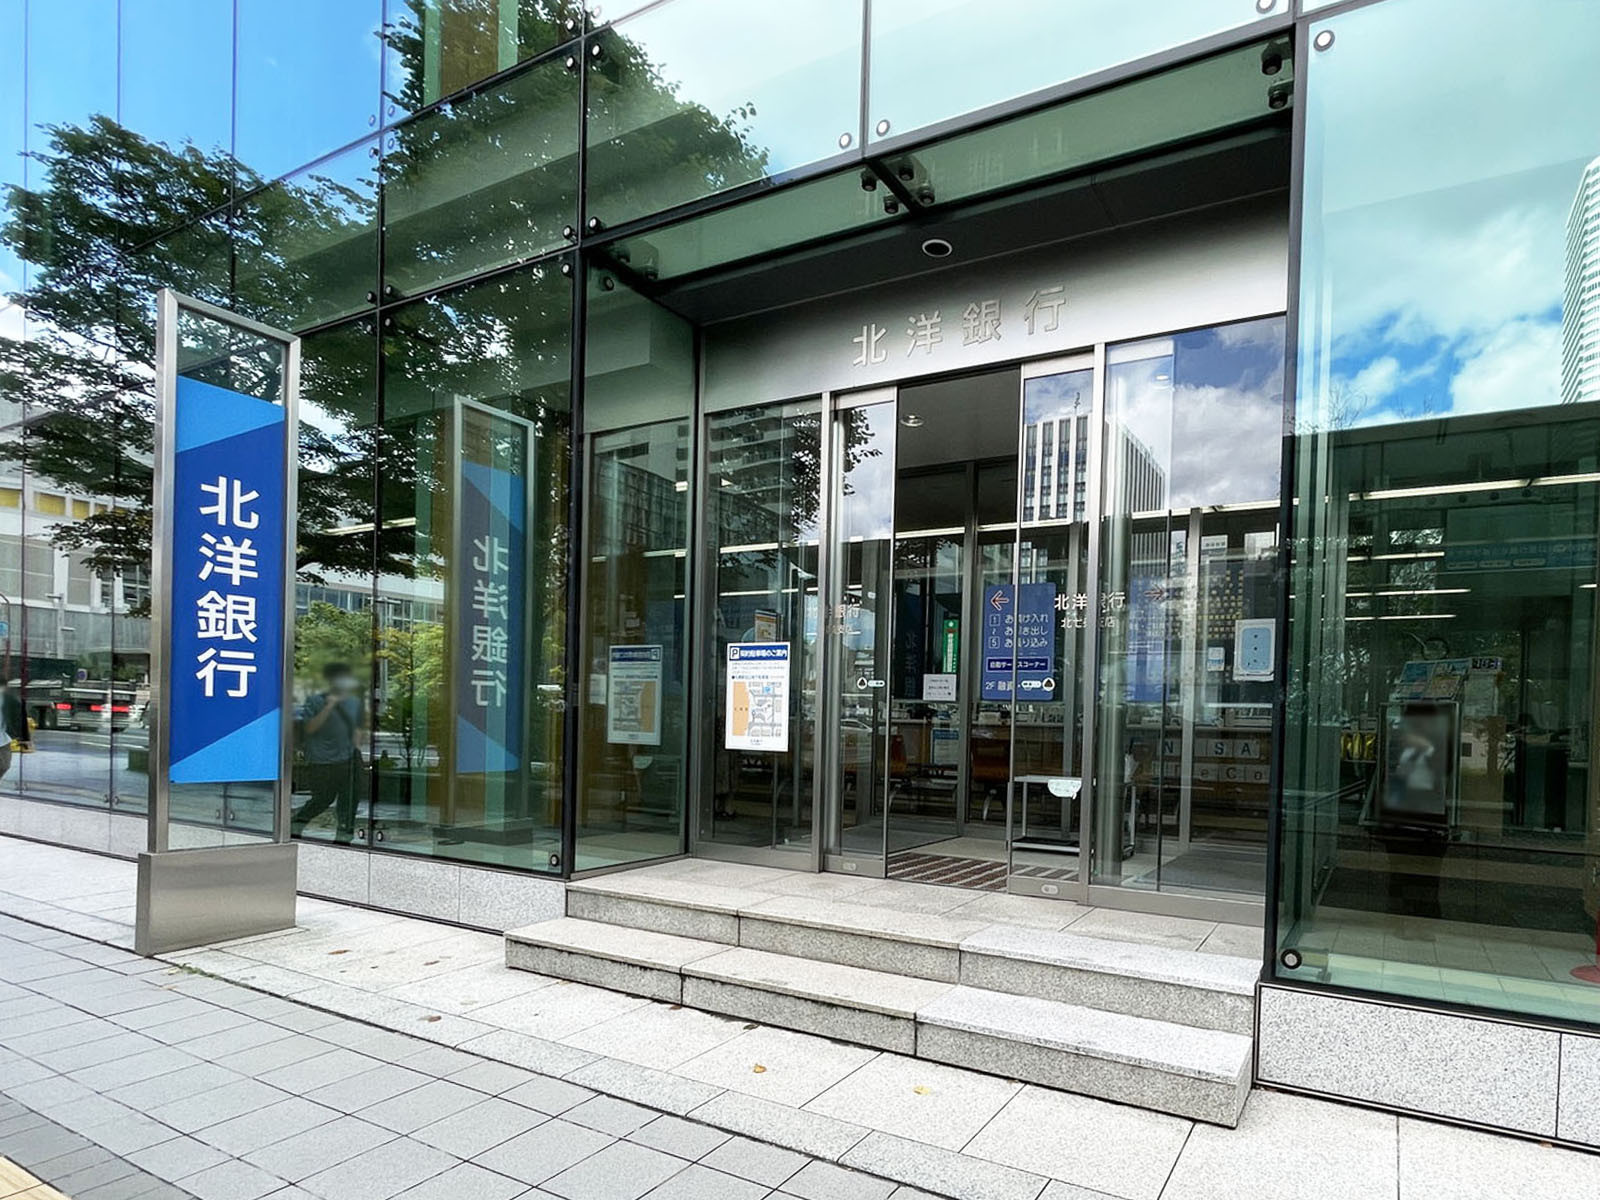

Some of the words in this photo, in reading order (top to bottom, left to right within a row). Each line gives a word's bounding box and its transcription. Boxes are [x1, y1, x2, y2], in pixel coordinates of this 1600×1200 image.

[852, 286, 1066, 367] 北洋銀行
[195, 476, 259, 699] 北洋銀行
[1004, 626, 1049, 636] おき出し
[989, 661, 1047, 669] 自動サースコーナー
[1163, 740, 1252, 756] NSA
